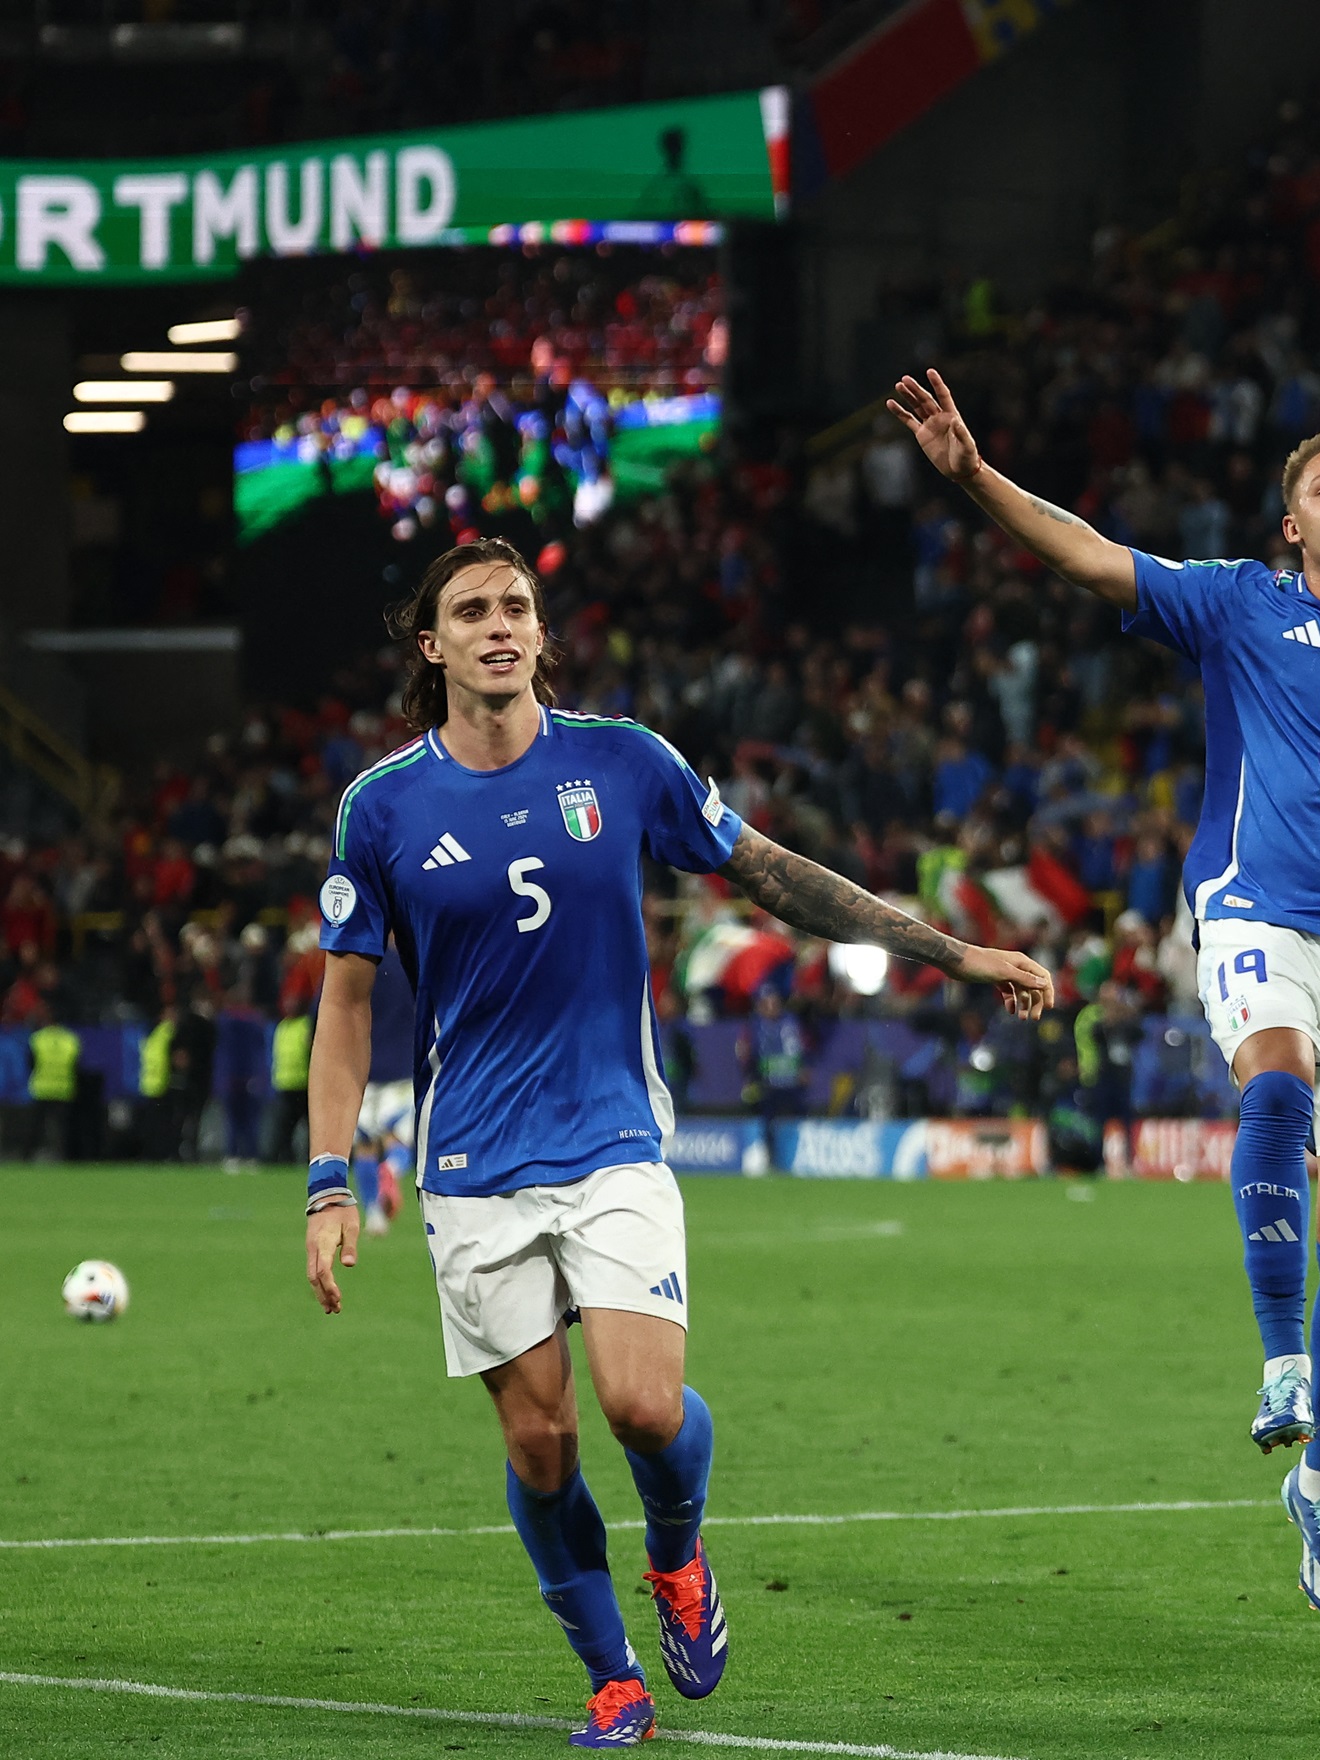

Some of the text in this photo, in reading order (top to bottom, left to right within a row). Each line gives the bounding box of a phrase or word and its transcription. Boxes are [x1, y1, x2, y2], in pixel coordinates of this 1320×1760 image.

[0, 144, 457, 272] RTMUND
[561, 791, 594, 807] ITALIA
[507, 856, 552, 933] 5
[1217, 948, 1269, 1003] 19
[1239, 1182, 1300, 1201] ITALIA
